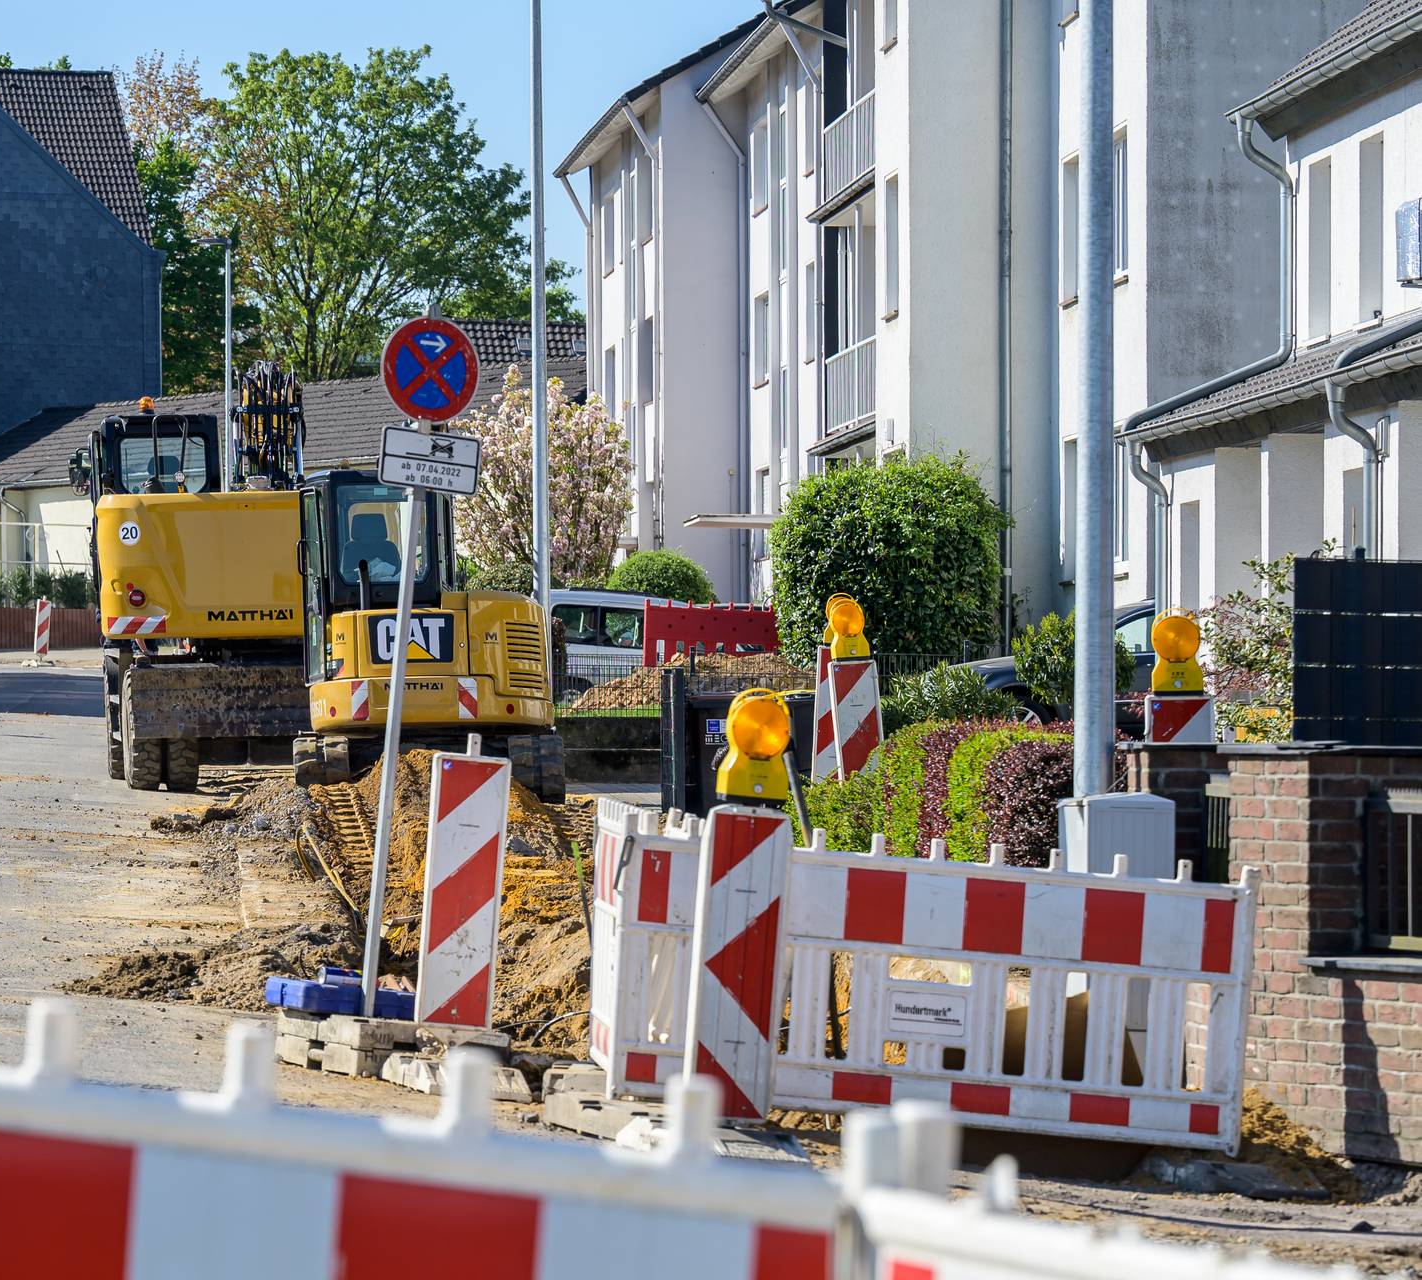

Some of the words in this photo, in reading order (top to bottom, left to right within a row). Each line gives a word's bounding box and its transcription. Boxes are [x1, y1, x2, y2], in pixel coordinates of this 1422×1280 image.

[401, 462, 411, 470] ab
[416, 463, 461, 477] 07.04.2022
[405, 474, 415, 482] ab
[121, 526, 139, 540] 20
[207, 608, 294, 622] MATTHÄI
[376, 617, 446, 662] CAT
